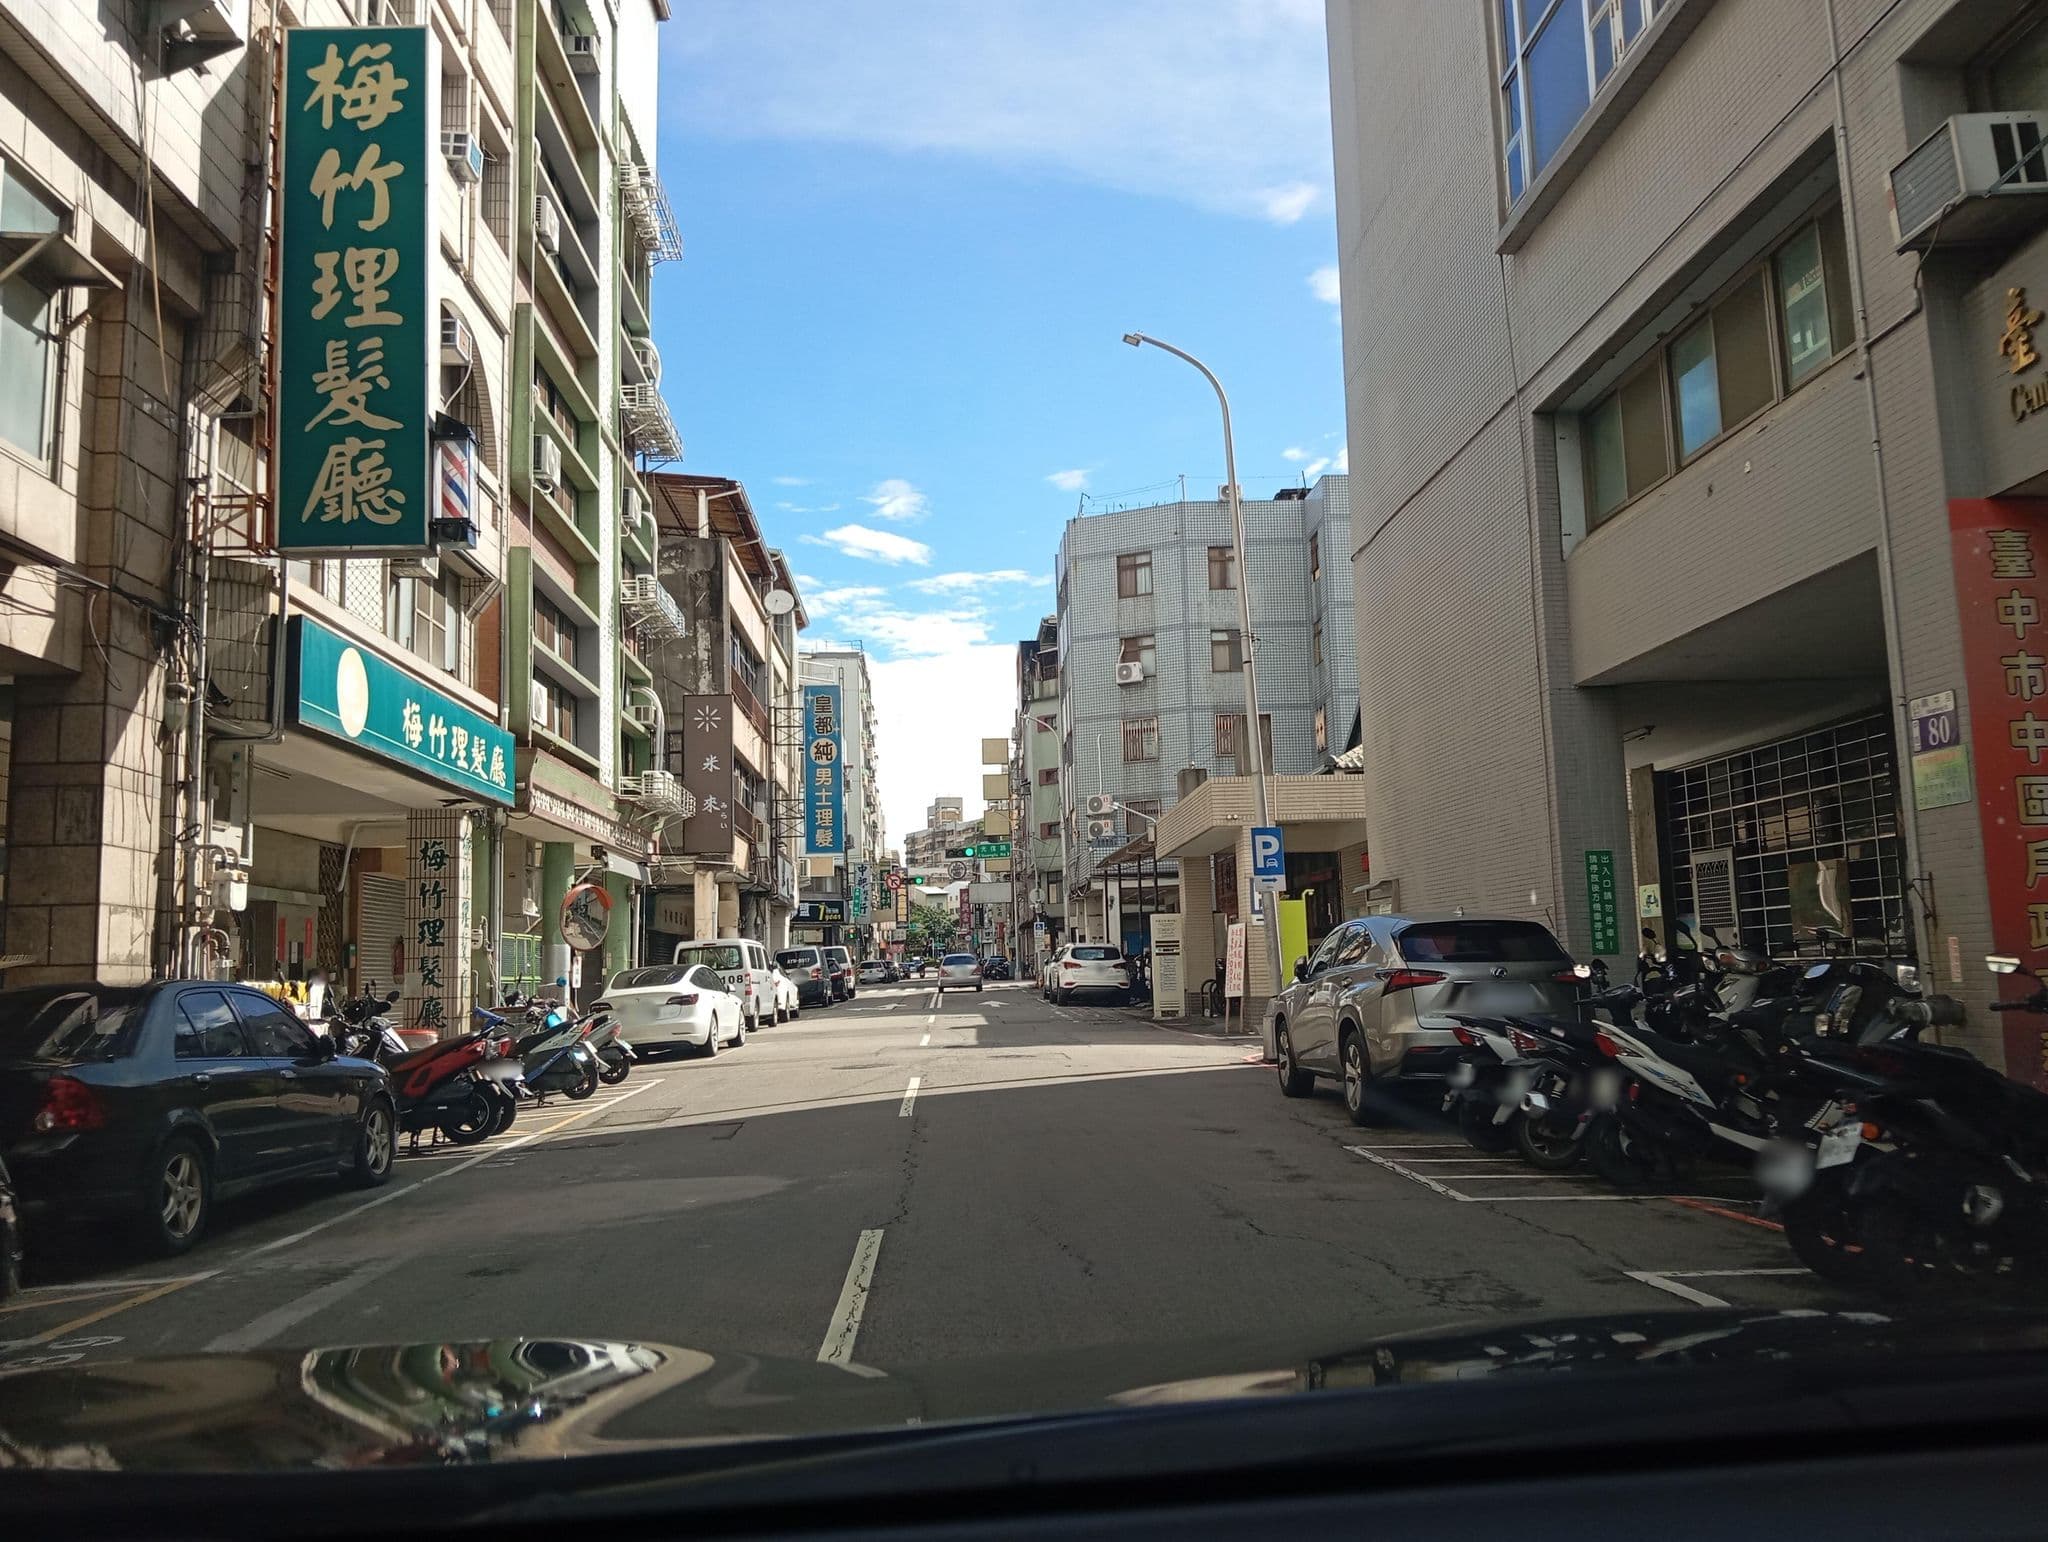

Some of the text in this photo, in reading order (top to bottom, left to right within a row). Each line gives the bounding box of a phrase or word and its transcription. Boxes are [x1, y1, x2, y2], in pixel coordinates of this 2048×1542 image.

[302, 43, 409, 525] 梅竹理髮廳
[402, 698, 507, 788] 梅竹理髮廳
[813, 695, 833, 848] 皇都純男士理髮
[1928, 715, 1951, 746] 80
[1255, 835, 1279, 869] P
[415, 839, 450, 1029] 梅竹理髮廳
